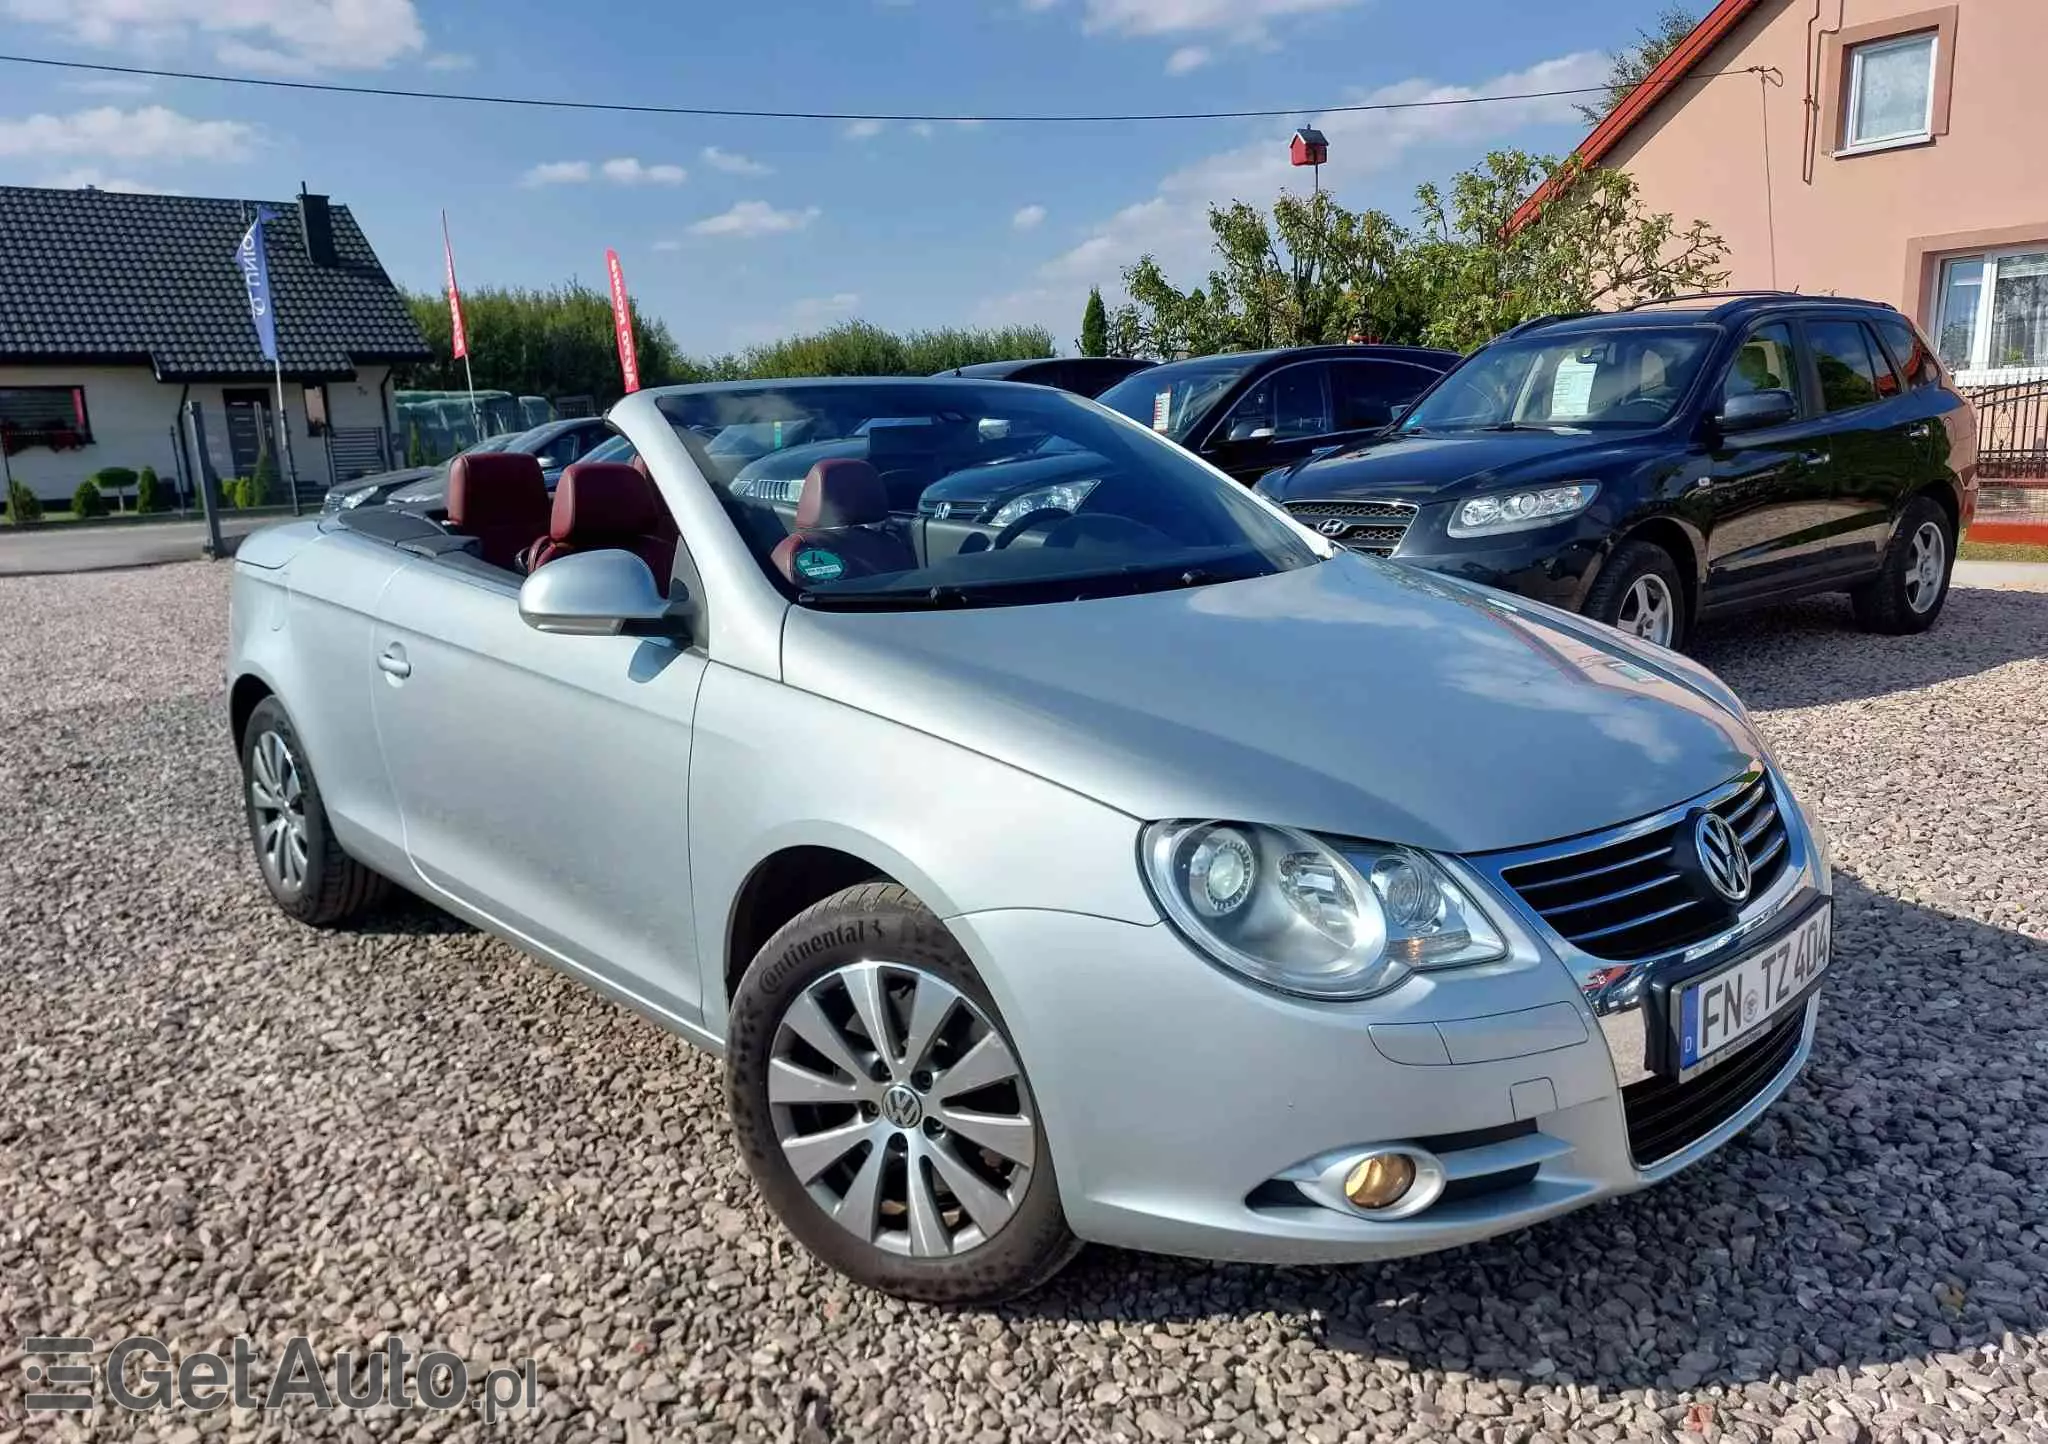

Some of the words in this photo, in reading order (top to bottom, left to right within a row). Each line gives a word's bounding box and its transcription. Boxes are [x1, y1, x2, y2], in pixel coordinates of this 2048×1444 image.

[758, 919, 865, 995] Continental
[1685, 1036, 1693, 1054] D
[1702, 972, 1743, 1049] FN
